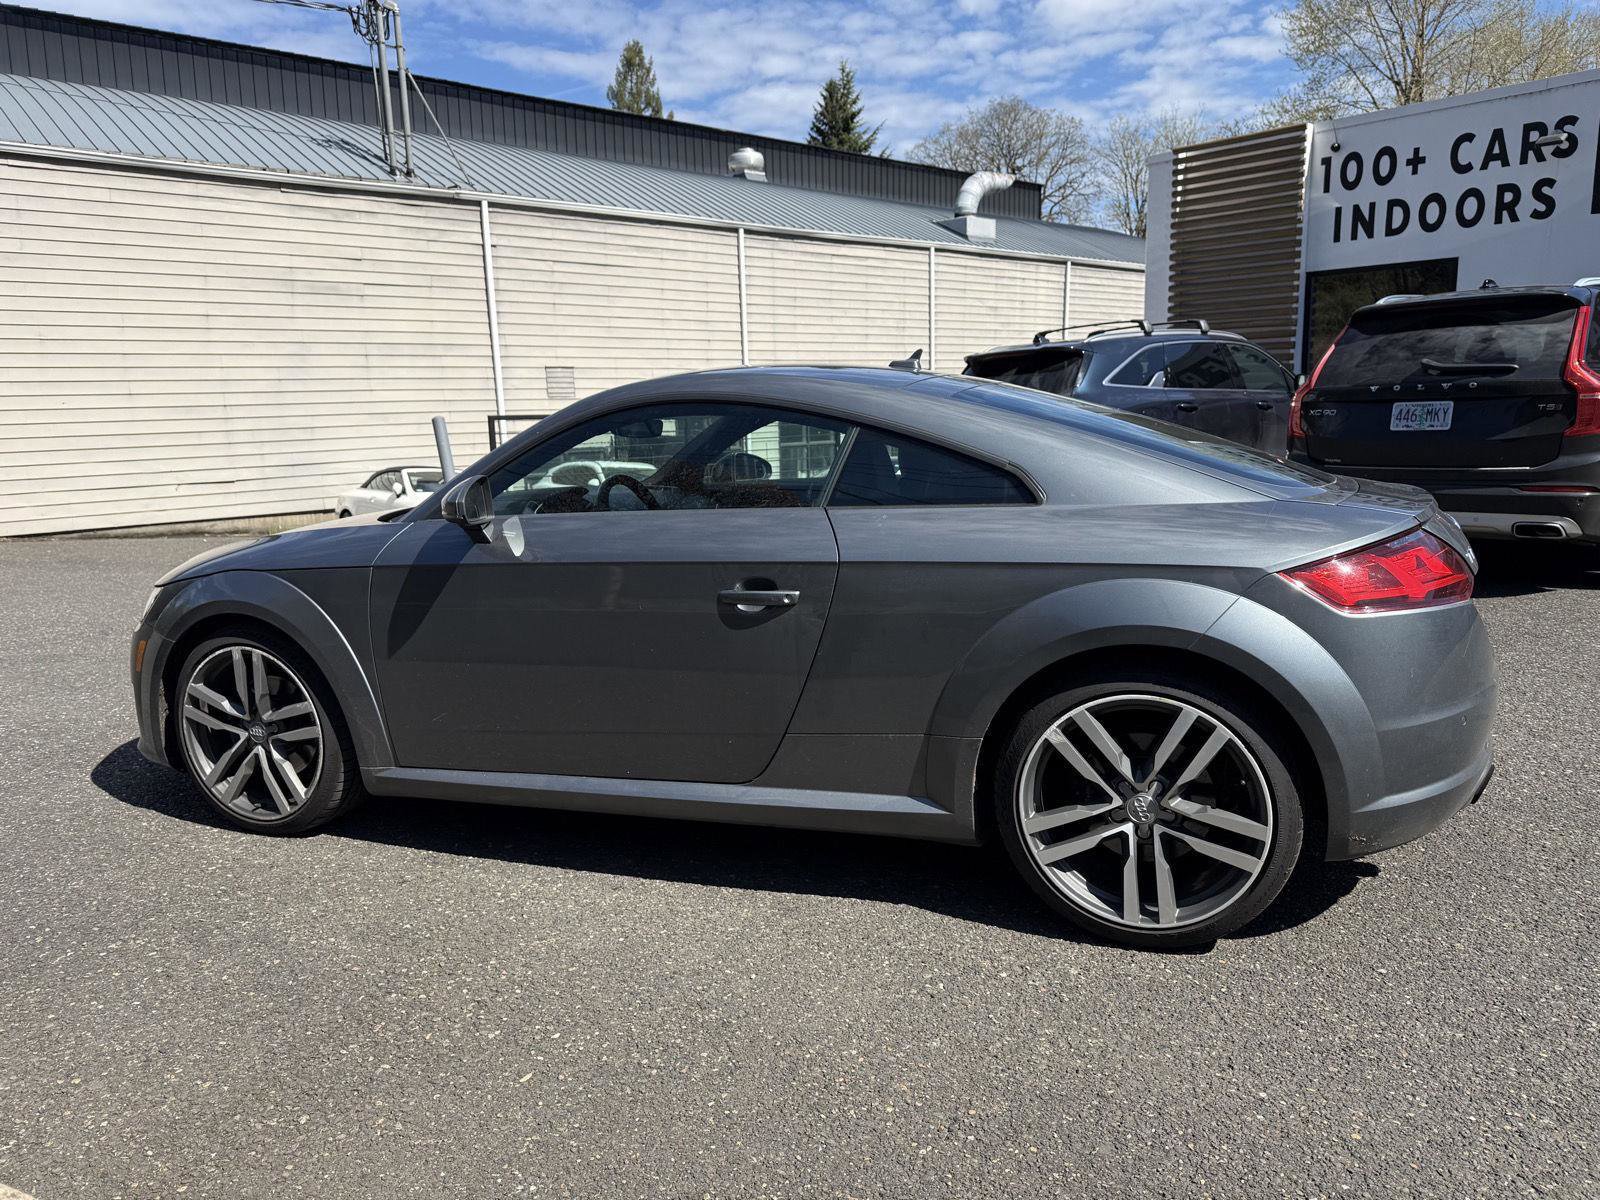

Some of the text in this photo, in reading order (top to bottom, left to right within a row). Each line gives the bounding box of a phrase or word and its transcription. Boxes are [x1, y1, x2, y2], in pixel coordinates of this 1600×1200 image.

[1320, 115, 1580, 193] 100+ CARS
[1333, 177, 1558, 243] INDOORS
[1369, 381, 1478, 393] VOLVO
[1396, 407, 1450, 423] 446 MKY
